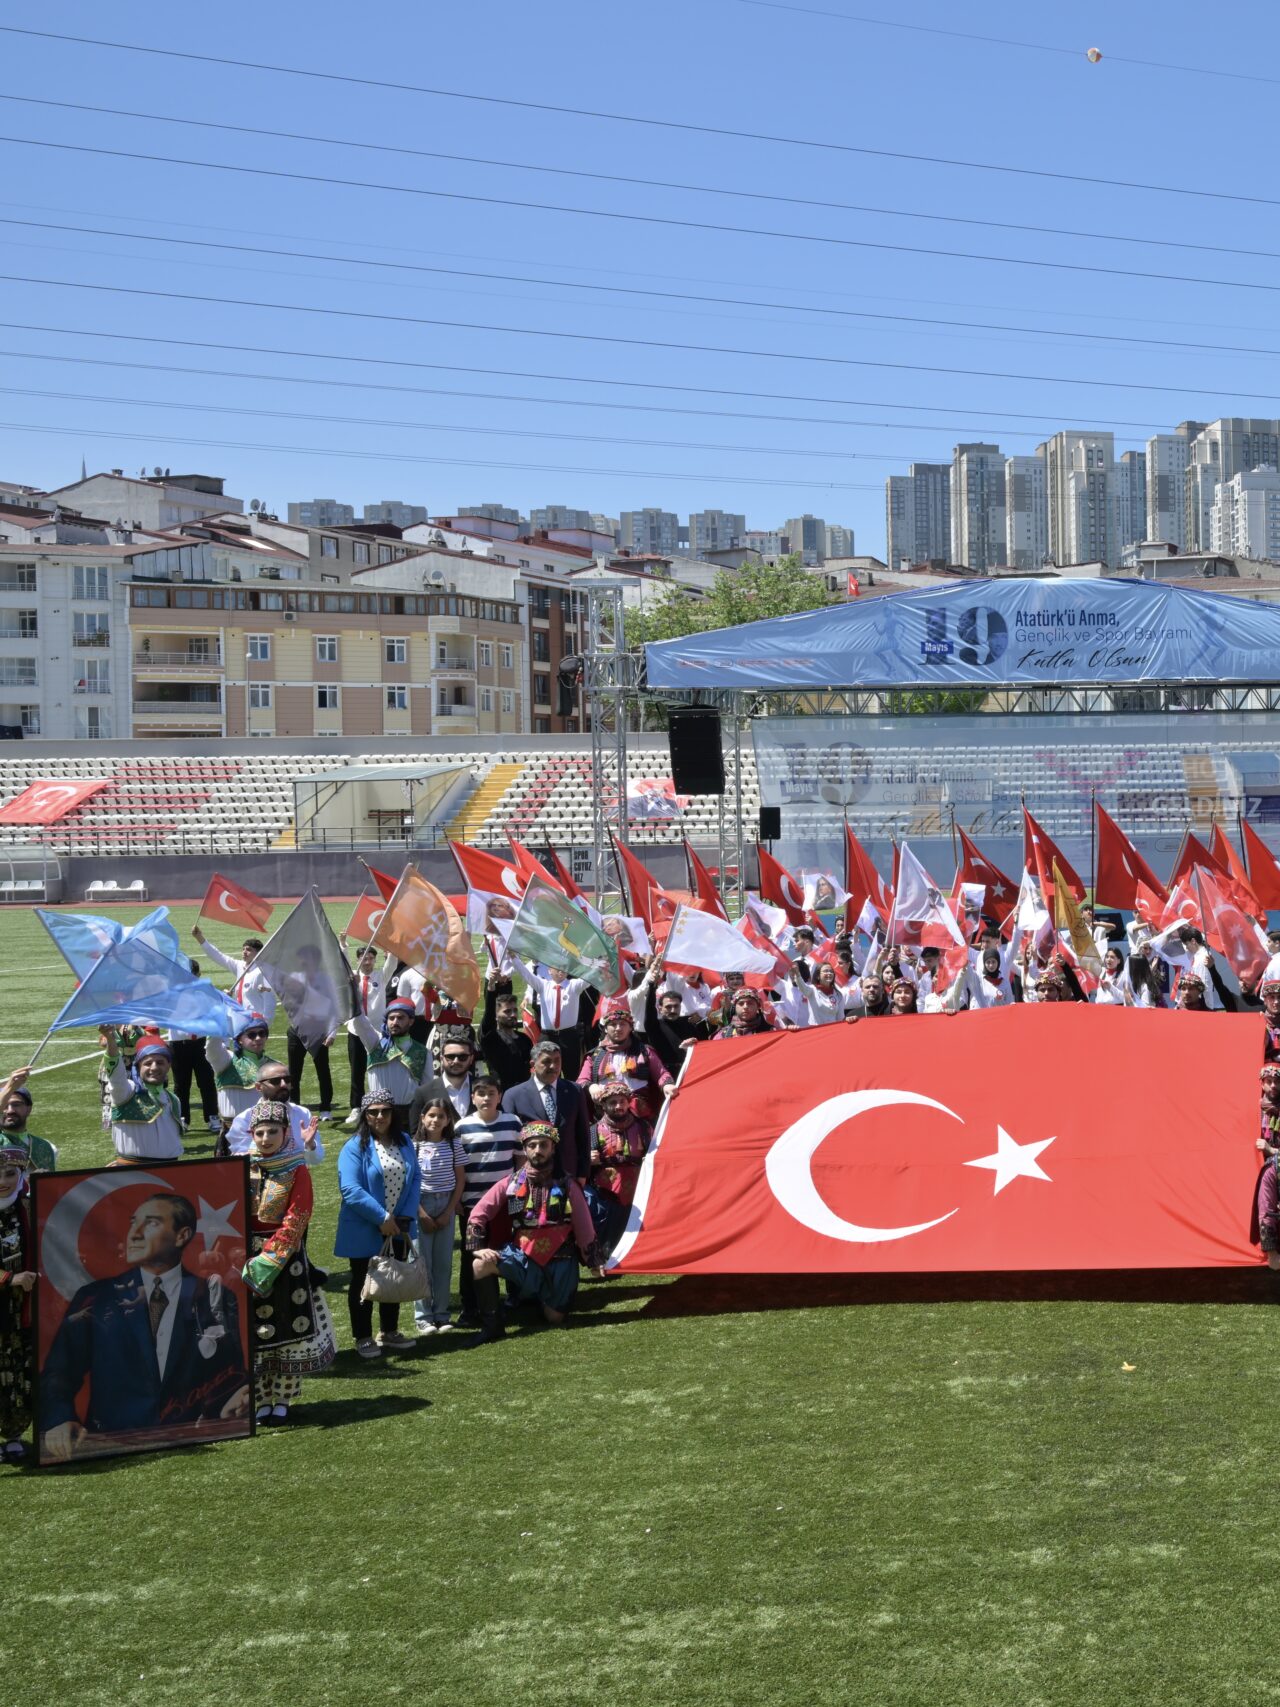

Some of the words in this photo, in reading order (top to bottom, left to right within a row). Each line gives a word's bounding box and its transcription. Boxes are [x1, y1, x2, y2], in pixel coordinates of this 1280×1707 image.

[1015, 609, 1076, 627] Atatürk'ü
[1079, 609, 1120, 627] Anma,
[918, 606, 1009, 666] 19
[1015, 627, 1069, 645] Gençlik
[1073, 632, 1091, 642] ve
[1095, 629, 1129, 646] Spor
[1134, 627, 1192, 645] Bayramı
[925, 641, 949, 653] Mayıs
[1017, 648, 1074, 669] Kutlu
[1088, 647, 1149, 668] Olsun
[785, 781, 814, 796] Mayıs
